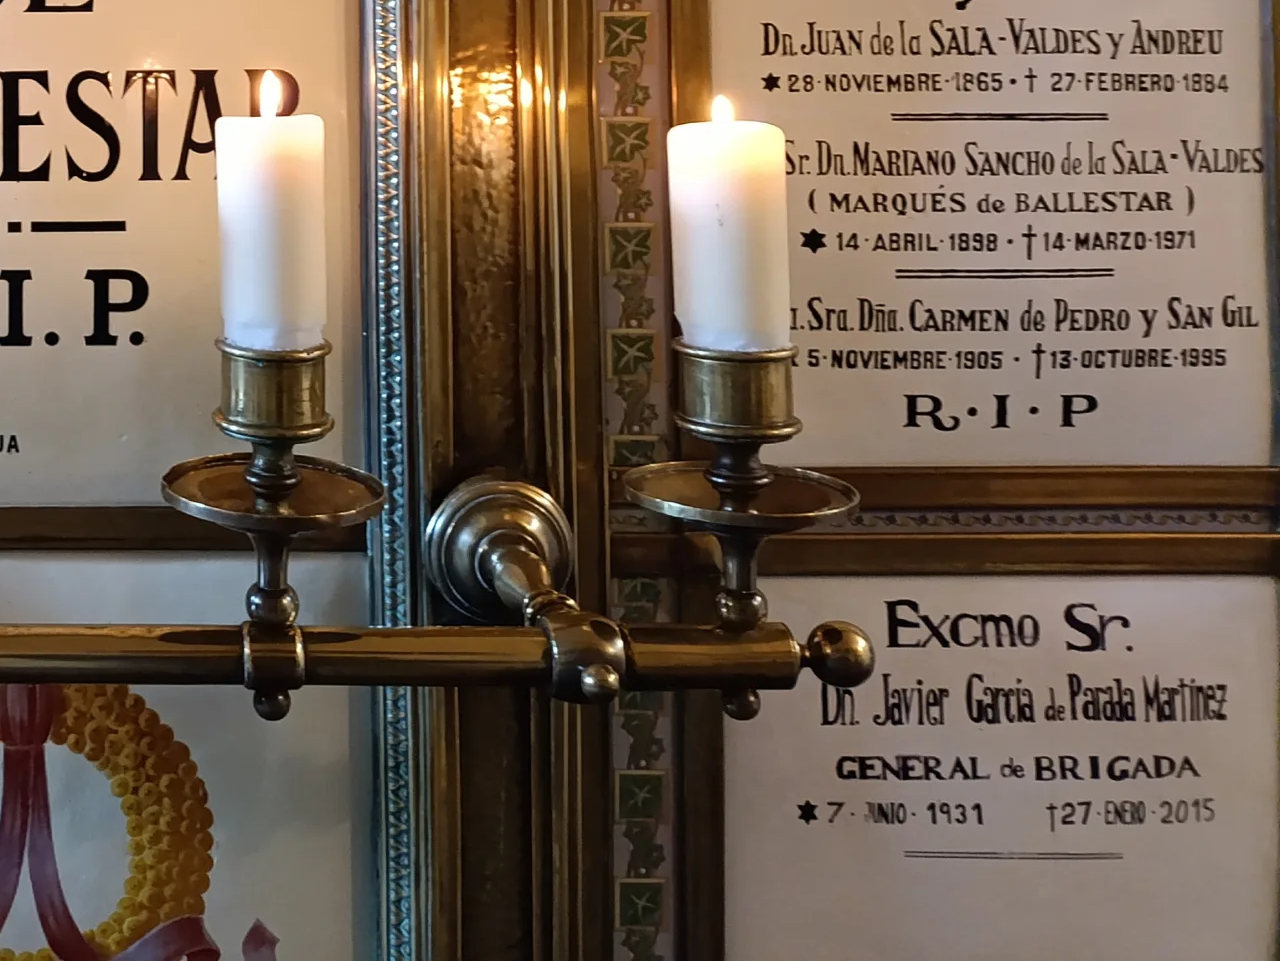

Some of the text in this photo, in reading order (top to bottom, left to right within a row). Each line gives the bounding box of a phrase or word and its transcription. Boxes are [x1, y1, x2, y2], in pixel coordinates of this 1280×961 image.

[870, 21, 894, 55] de
[899, 20, 921, 55] la
[1061, 142, 1082, 175] de
[1088, 141, 1106, 175] la
[829, 185, 1173, 216] MARQUÉS de BALLESTAR
[1020, 299, 1045, 331] de
[884, 600, 1133, 652] Excmo Sr.
[873, 674, 949, 726] Javier
[1044, 688, 1065, 721] de
[836, 755, 1200, 781] GENERAL de BRIGADA
[927, 802, 983, 825] 1931
[1159, 798, 1215, 824] 2015
